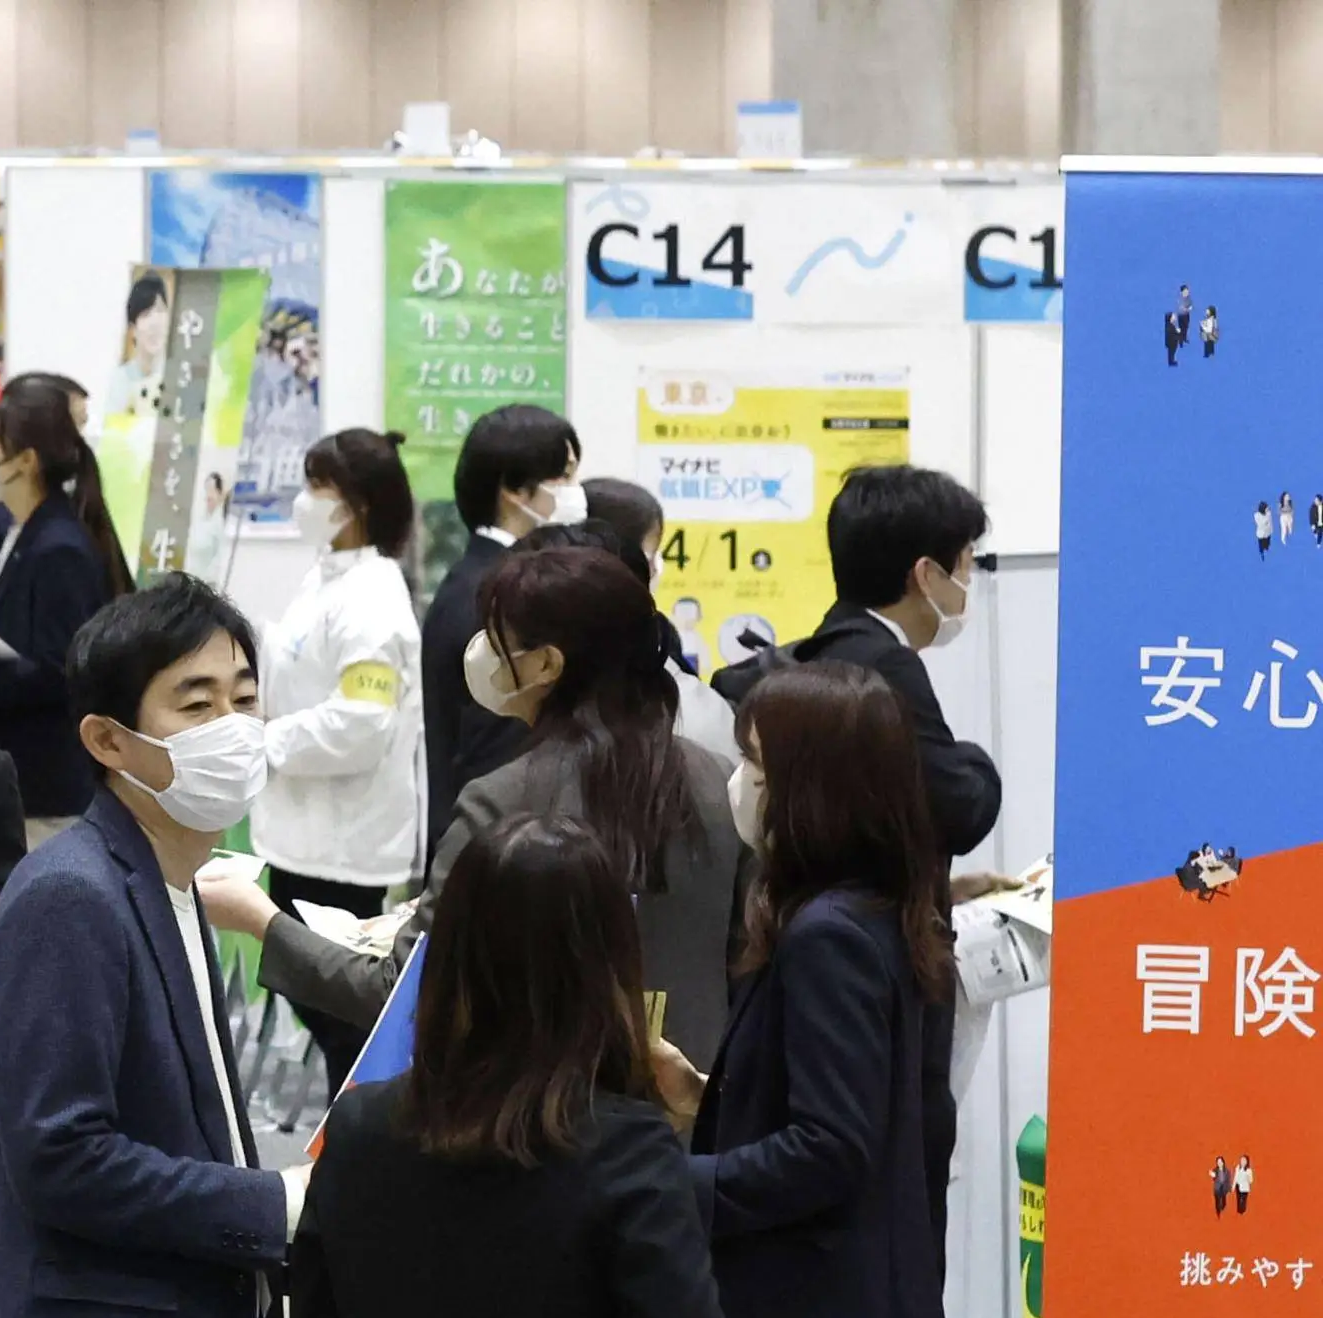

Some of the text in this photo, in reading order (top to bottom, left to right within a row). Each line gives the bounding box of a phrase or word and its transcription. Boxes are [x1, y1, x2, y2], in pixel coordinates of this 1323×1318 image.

[586, 222, 754, 288] C14
[659, 456, 721, 475] マイナビ
[1138, 636, 1323, 728] 安心
[1136, 944, 1321, 1038] 冒険
[1180, 1251, 1313, 1289] 挑みやす
